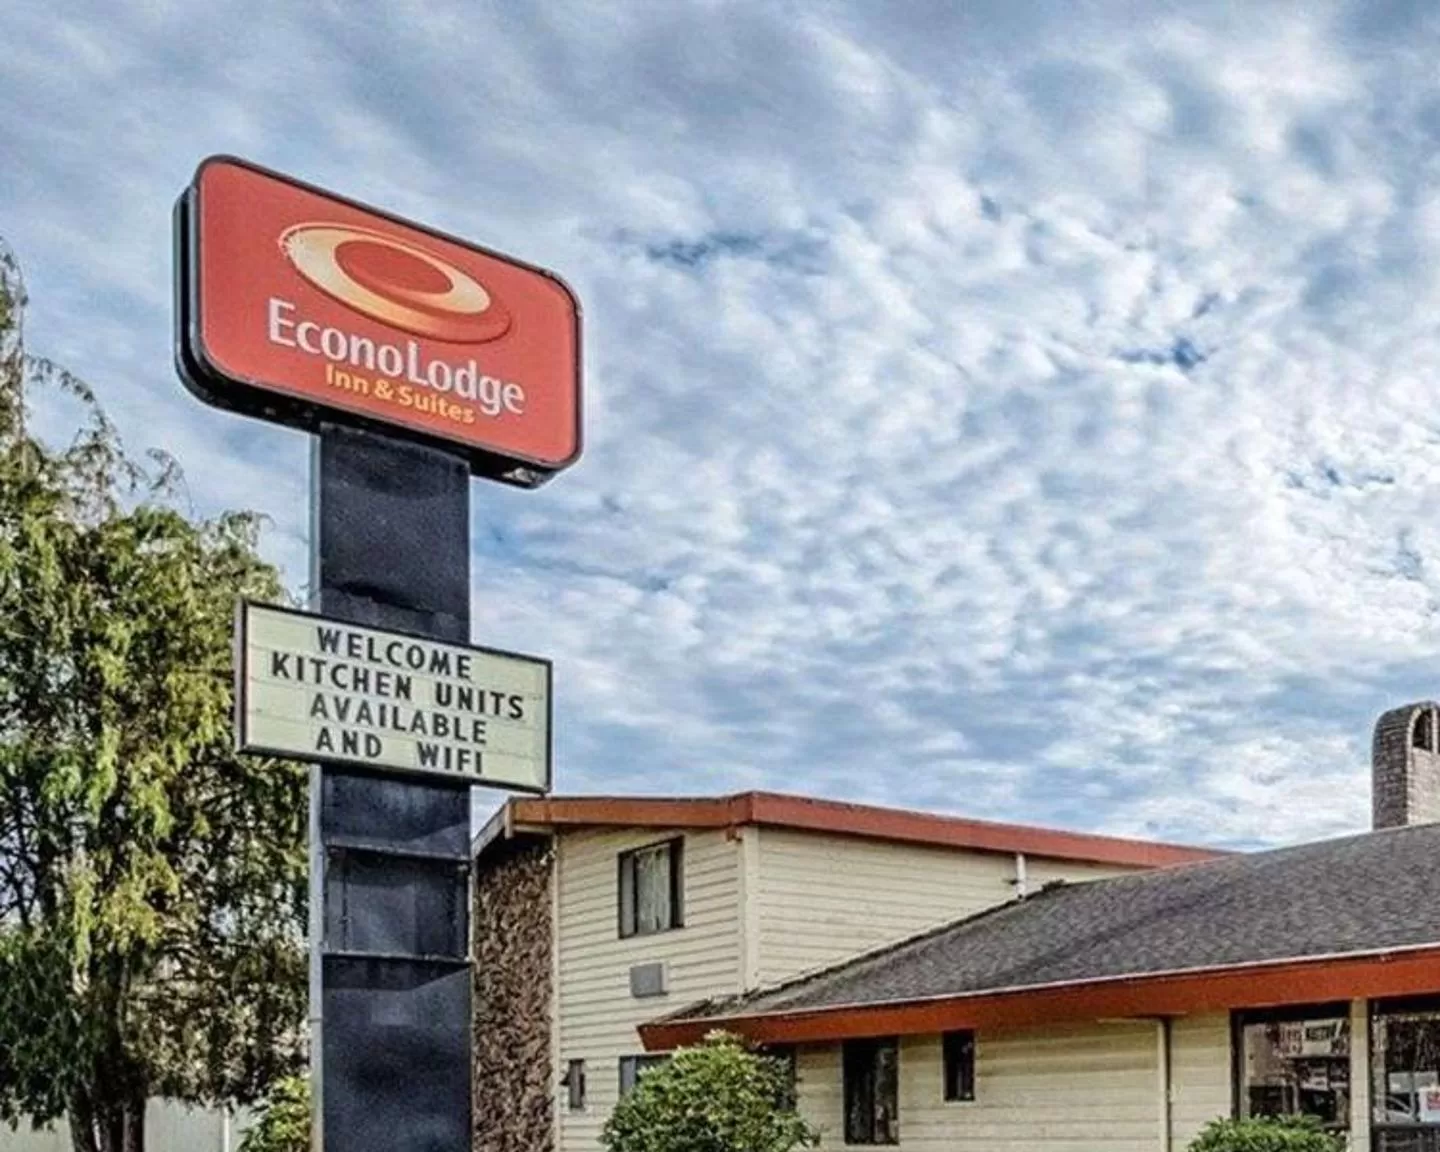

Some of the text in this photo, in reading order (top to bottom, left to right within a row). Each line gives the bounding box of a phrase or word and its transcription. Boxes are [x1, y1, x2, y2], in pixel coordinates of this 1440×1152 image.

[267, 297, 525, 417] EconoLodge
[325, 364, 476, 424] Inn & Suites
[317, 626, 471, 679] WELCOME
[272, 651, 524, 720] KITCHEN UNITS
[310, 693, 487, 744] AVAILABLE
[316, 727, 483, 774] AND WIFI
